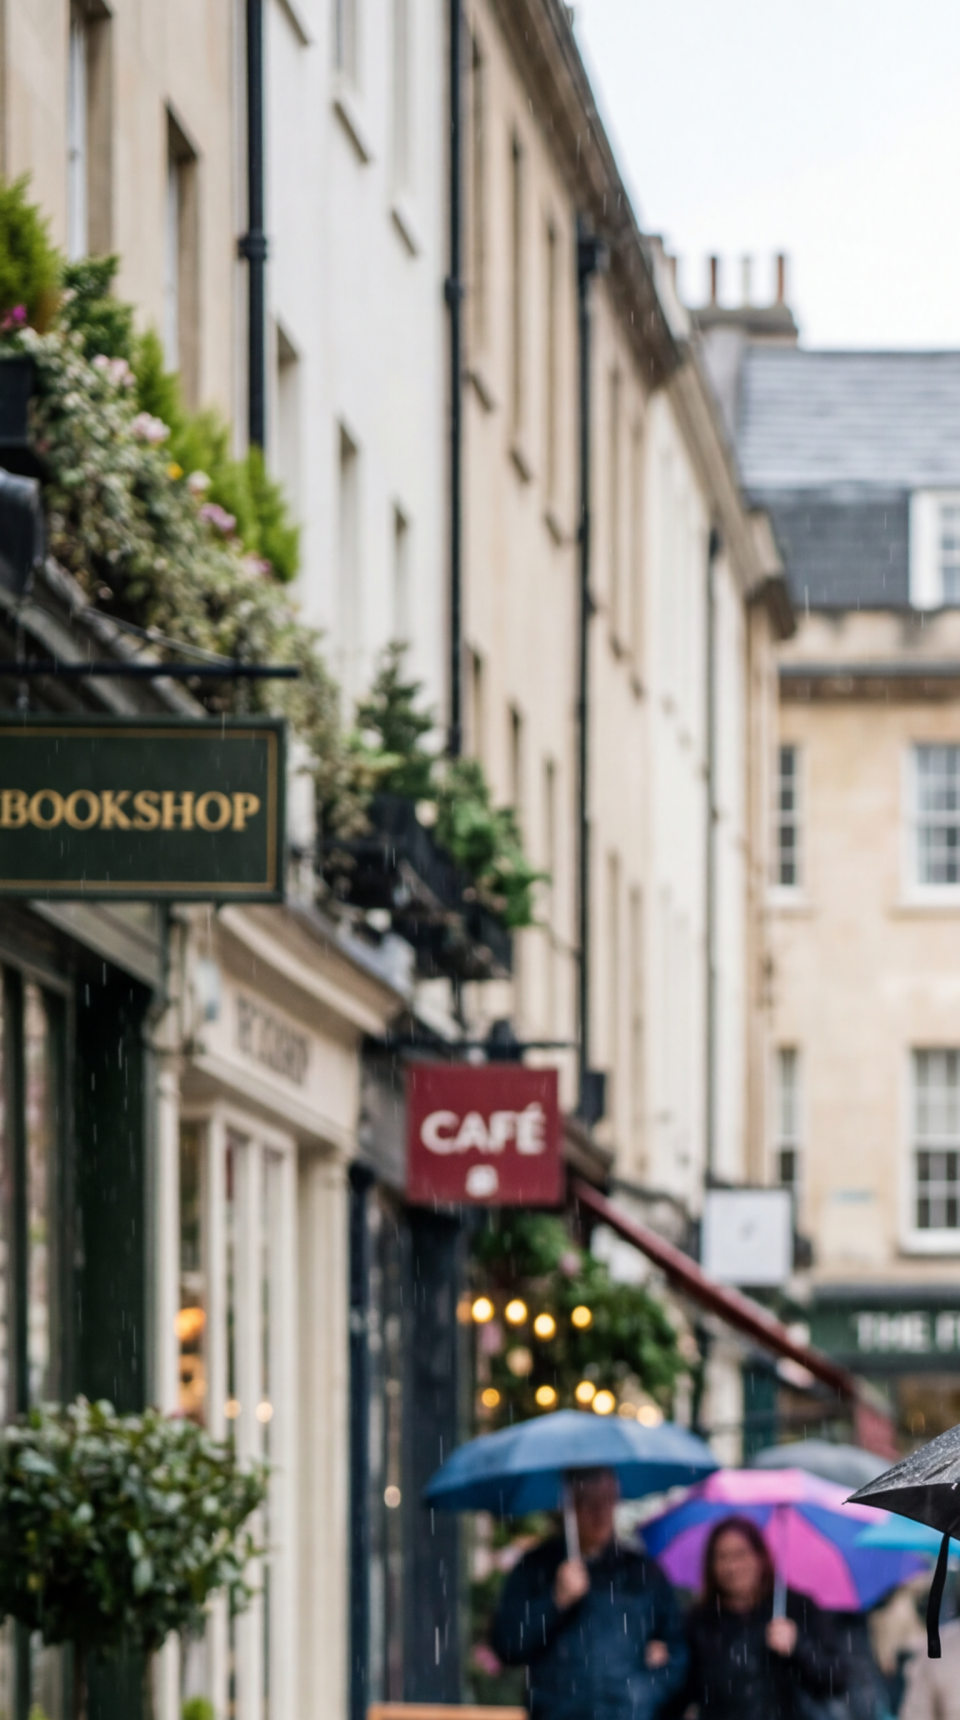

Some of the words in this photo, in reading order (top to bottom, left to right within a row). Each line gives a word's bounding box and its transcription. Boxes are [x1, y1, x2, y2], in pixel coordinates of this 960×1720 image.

[0, 788, 261, 832] BOOKSHOP
[420, 1101, 546, 1155] CAFÉ
[854, 1310, 930, 1352] THE
